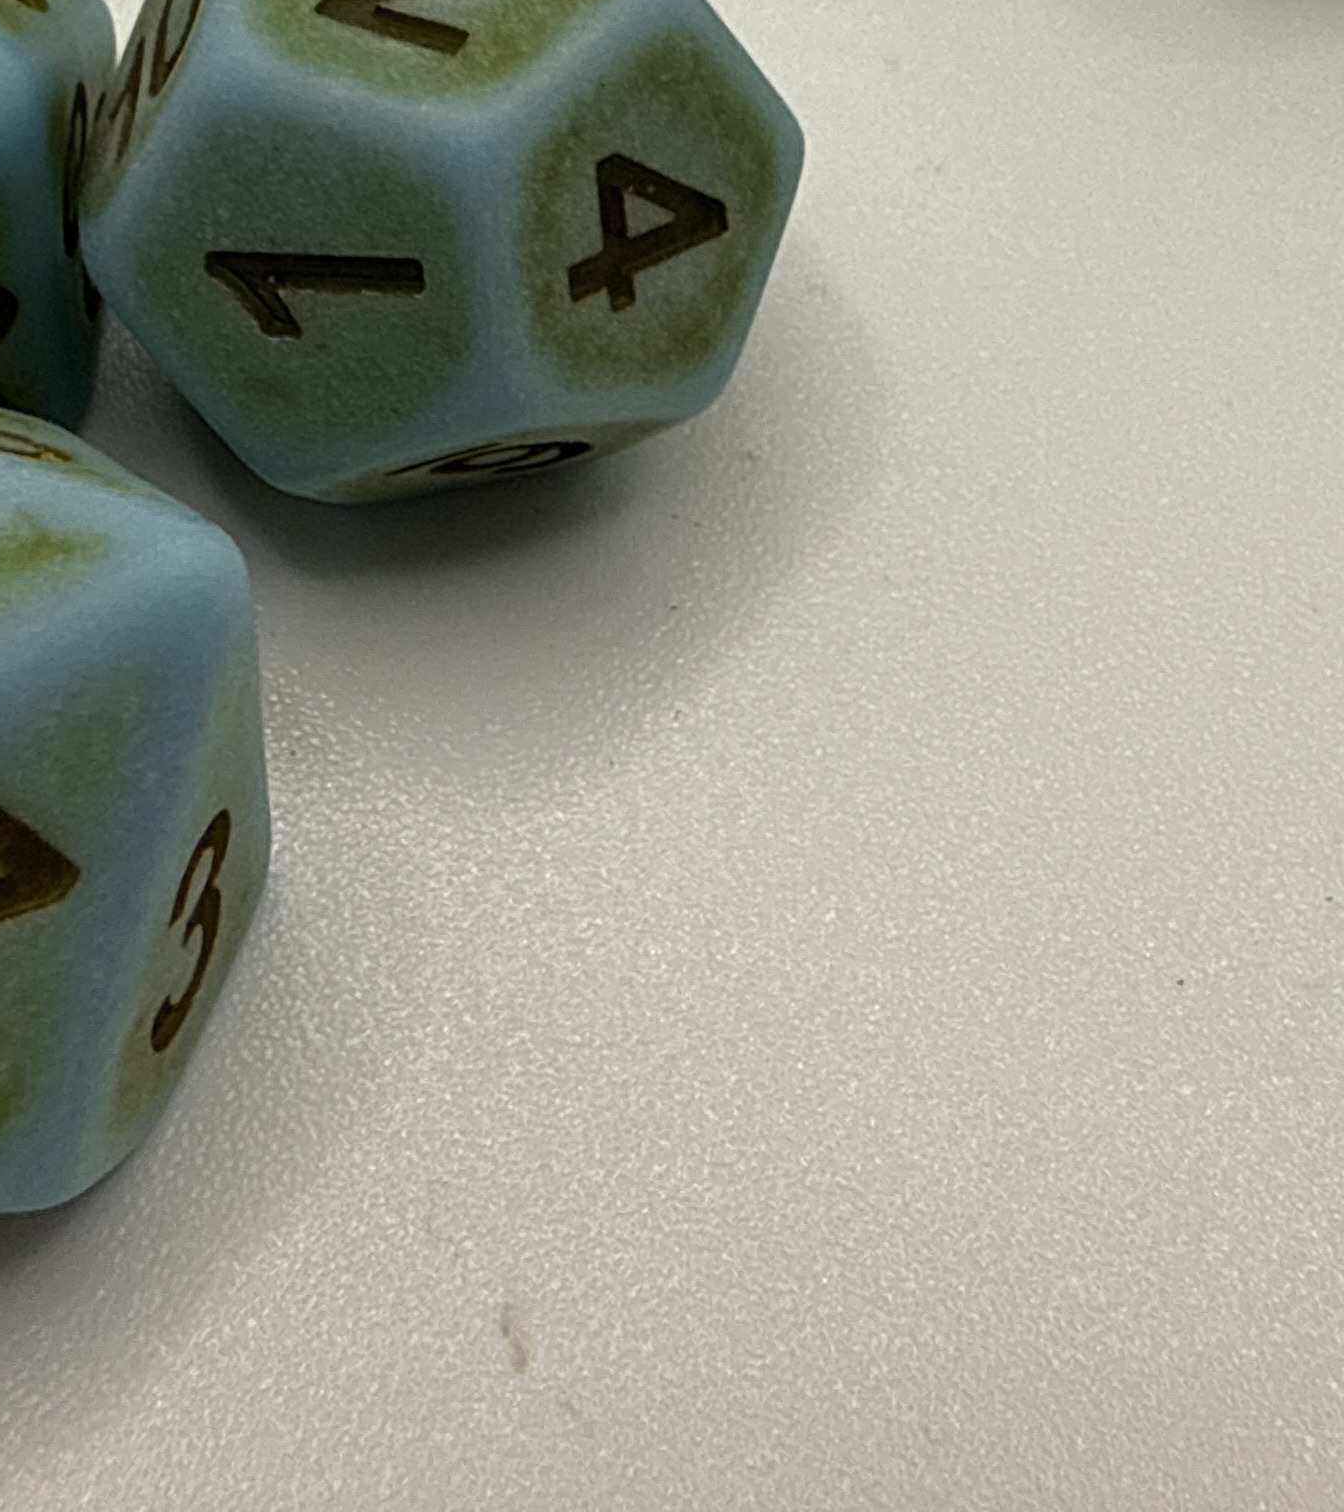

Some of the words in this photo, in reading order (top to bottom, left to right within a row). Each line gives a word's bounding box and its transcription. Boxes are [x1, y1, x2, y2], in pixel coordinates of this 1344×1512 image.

[205, 249, 426, 340] 1
[567, 152, 728, 314] 4
[150, 807, 233, 1054] 3
